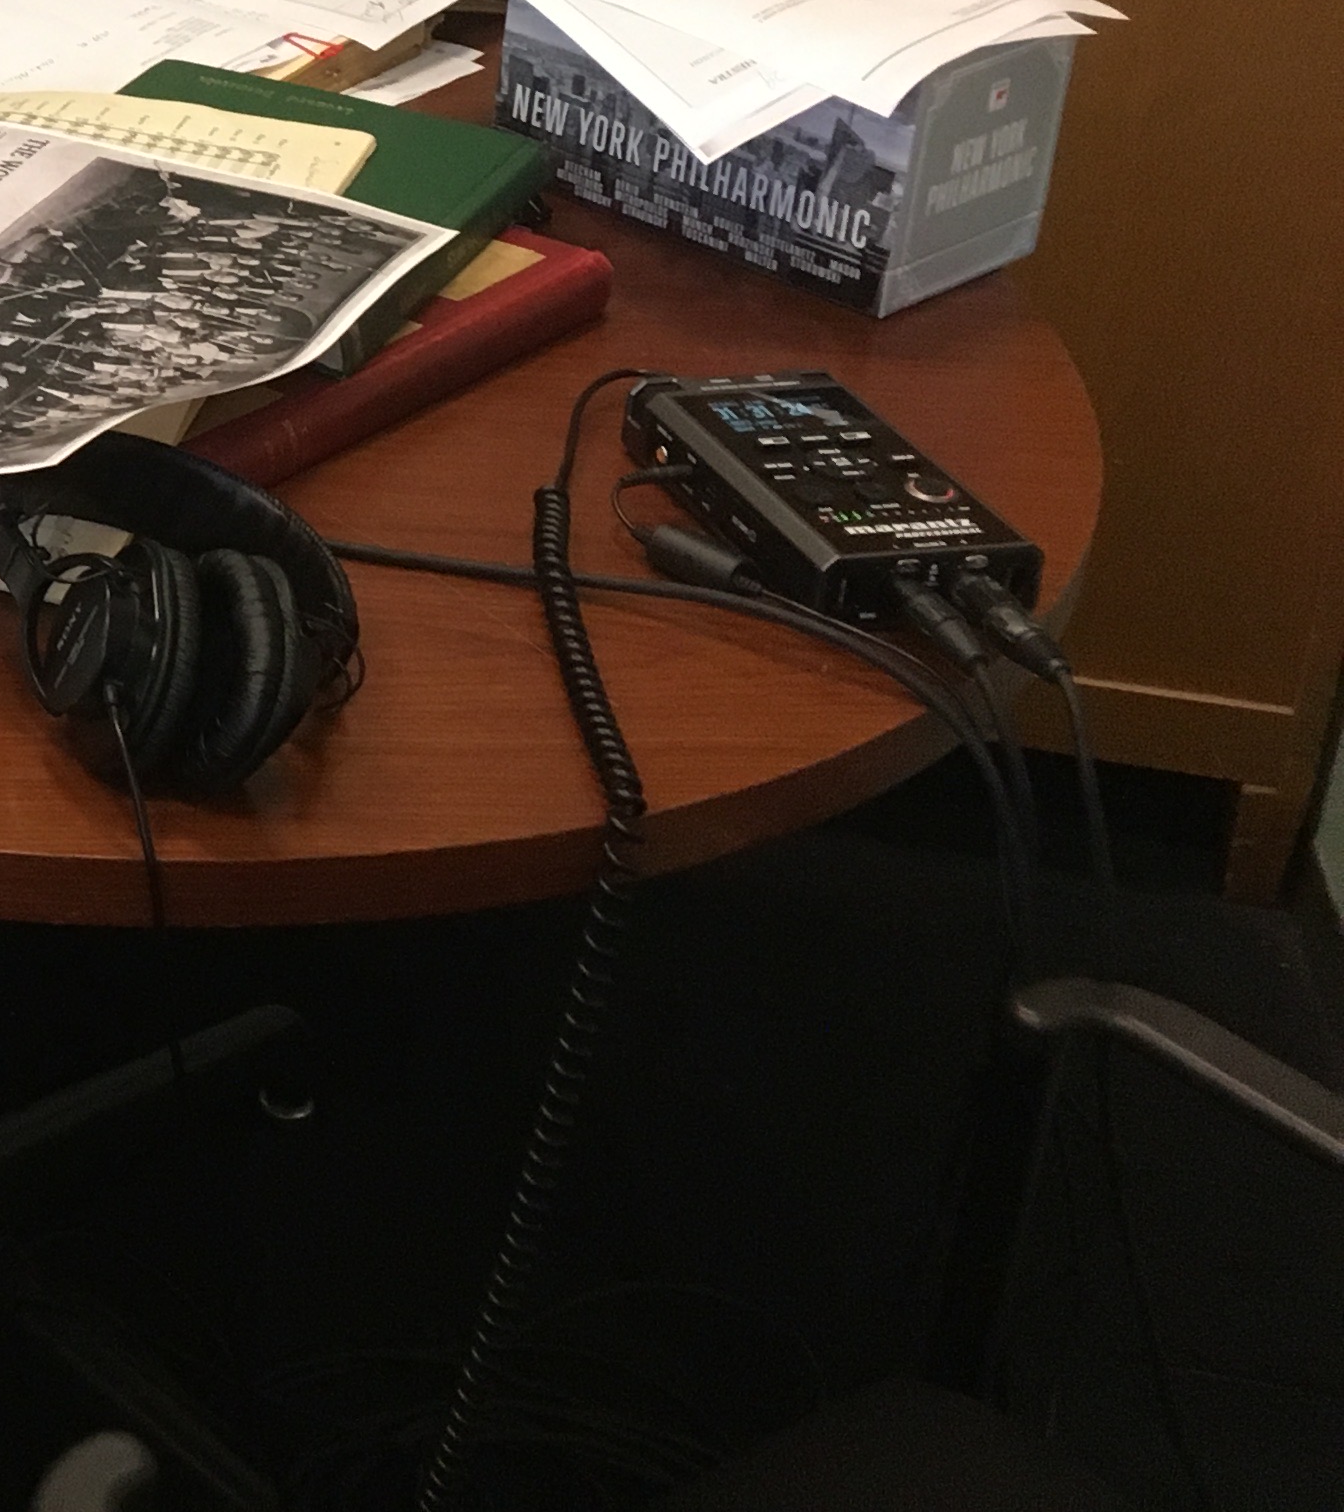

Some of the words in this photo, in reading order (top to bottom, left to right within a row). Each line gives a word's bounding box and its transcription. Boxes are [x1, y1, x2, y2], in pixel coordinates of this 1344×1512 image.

[11, 137, 47, 158] THE
[952, 133, 988, 175] NEW
[511, 83, 569, 136] NEW
[578, 107, 641, 166] YORK
[653, 136, 871, 248] PHILHARMONIC
[844, 518, 978, 535] marantz
